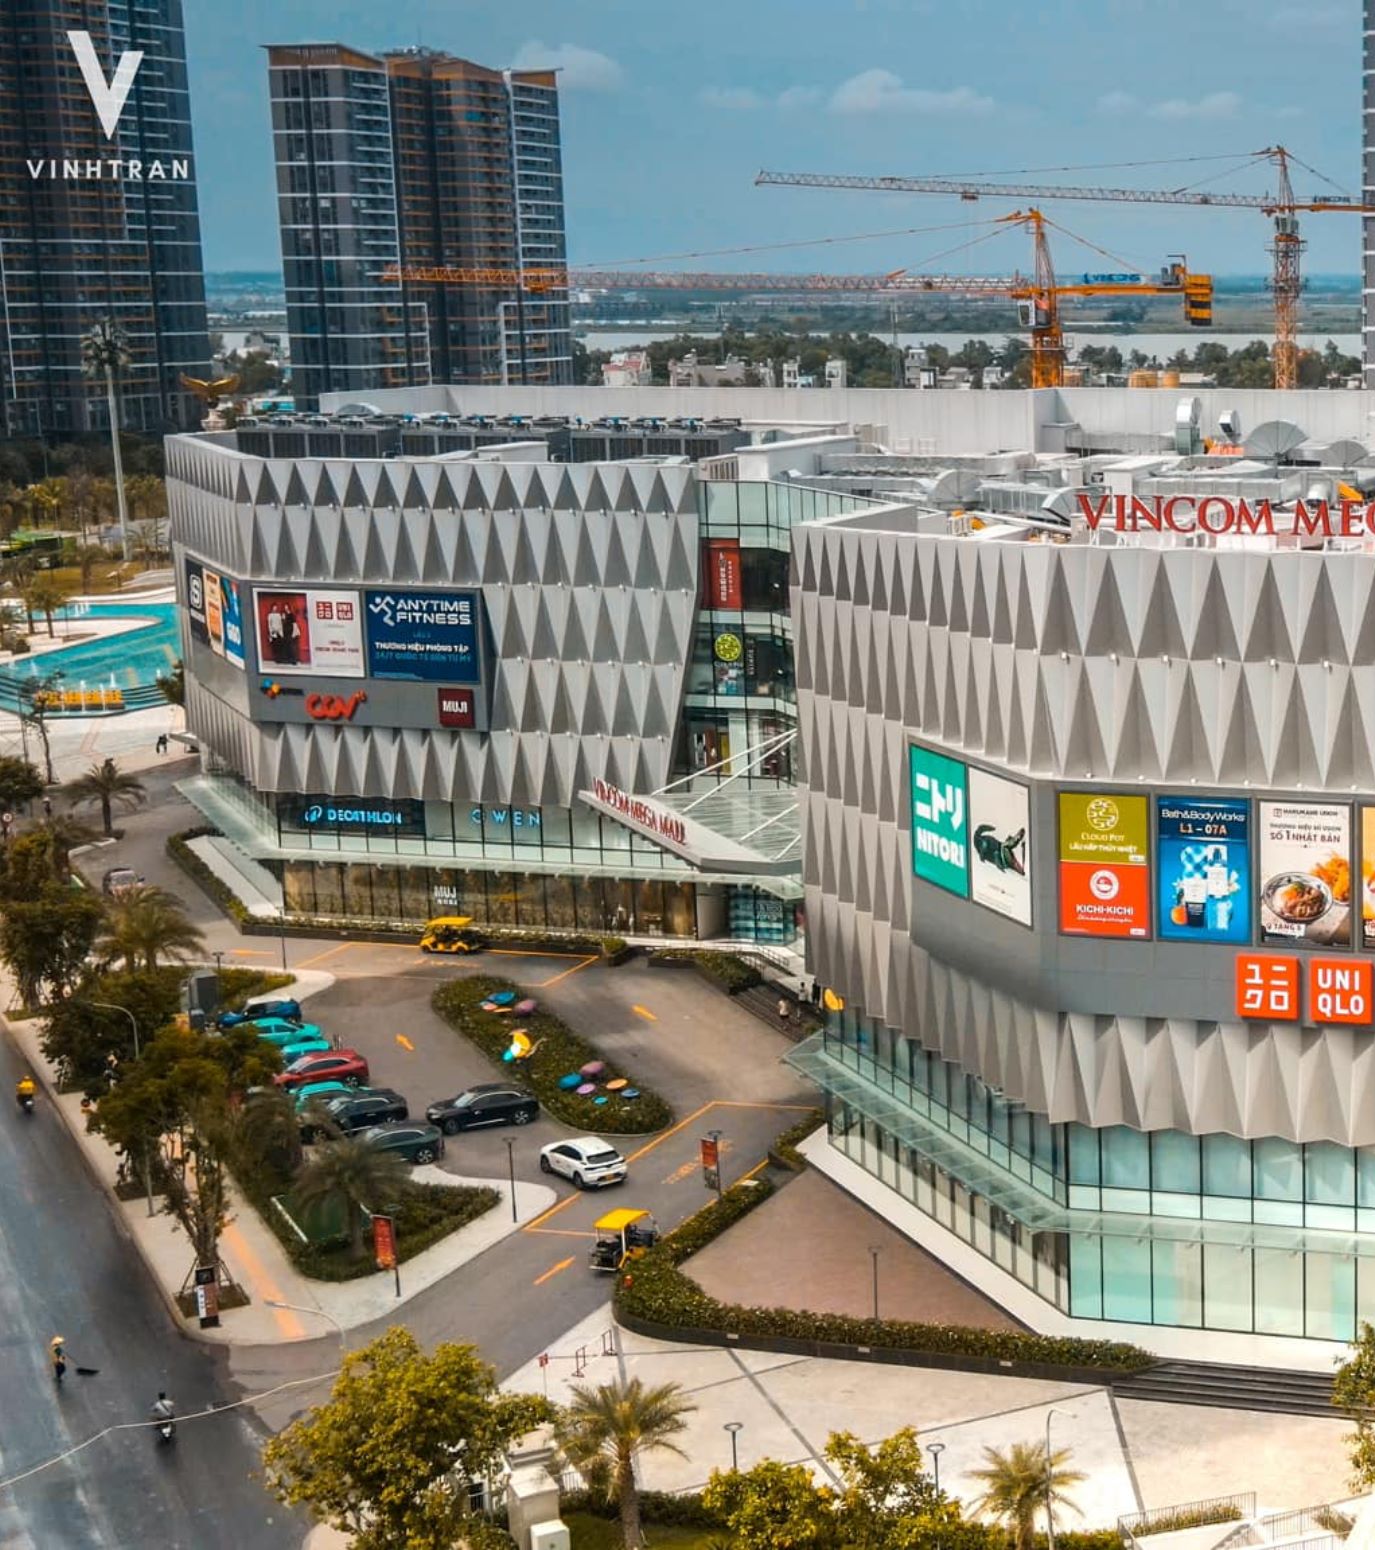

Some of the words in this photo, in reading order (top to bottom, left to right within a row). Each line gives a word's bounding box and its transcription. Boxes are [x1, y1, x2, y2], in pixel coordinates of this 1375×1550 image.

[1075, 494, 1276, 535] VINCOM
[396, 599, 470, 612] ANYTIME
[396, 612, 471, 625] FITNESS
[305, 692, 360, 721] CGV
[442, 700, 467, 713] MUJI
[328, 809, 402, 824] DECATHLON
[631, 799, 658, 832] MEGA
[660, 812, 686, 845] MALL
[1180, 823, 1193, 834] L1
[1205, 824, 1227, 835] 07A
[917, 827, 964, 869] NITORI
[434, 885, 459, 898] MUJ
[1076, 903, 1134, 916] KICHI-KICHI
[1317, 968, 1360, 991] UNI
[1317, 993, 1364, 1018] QLO
